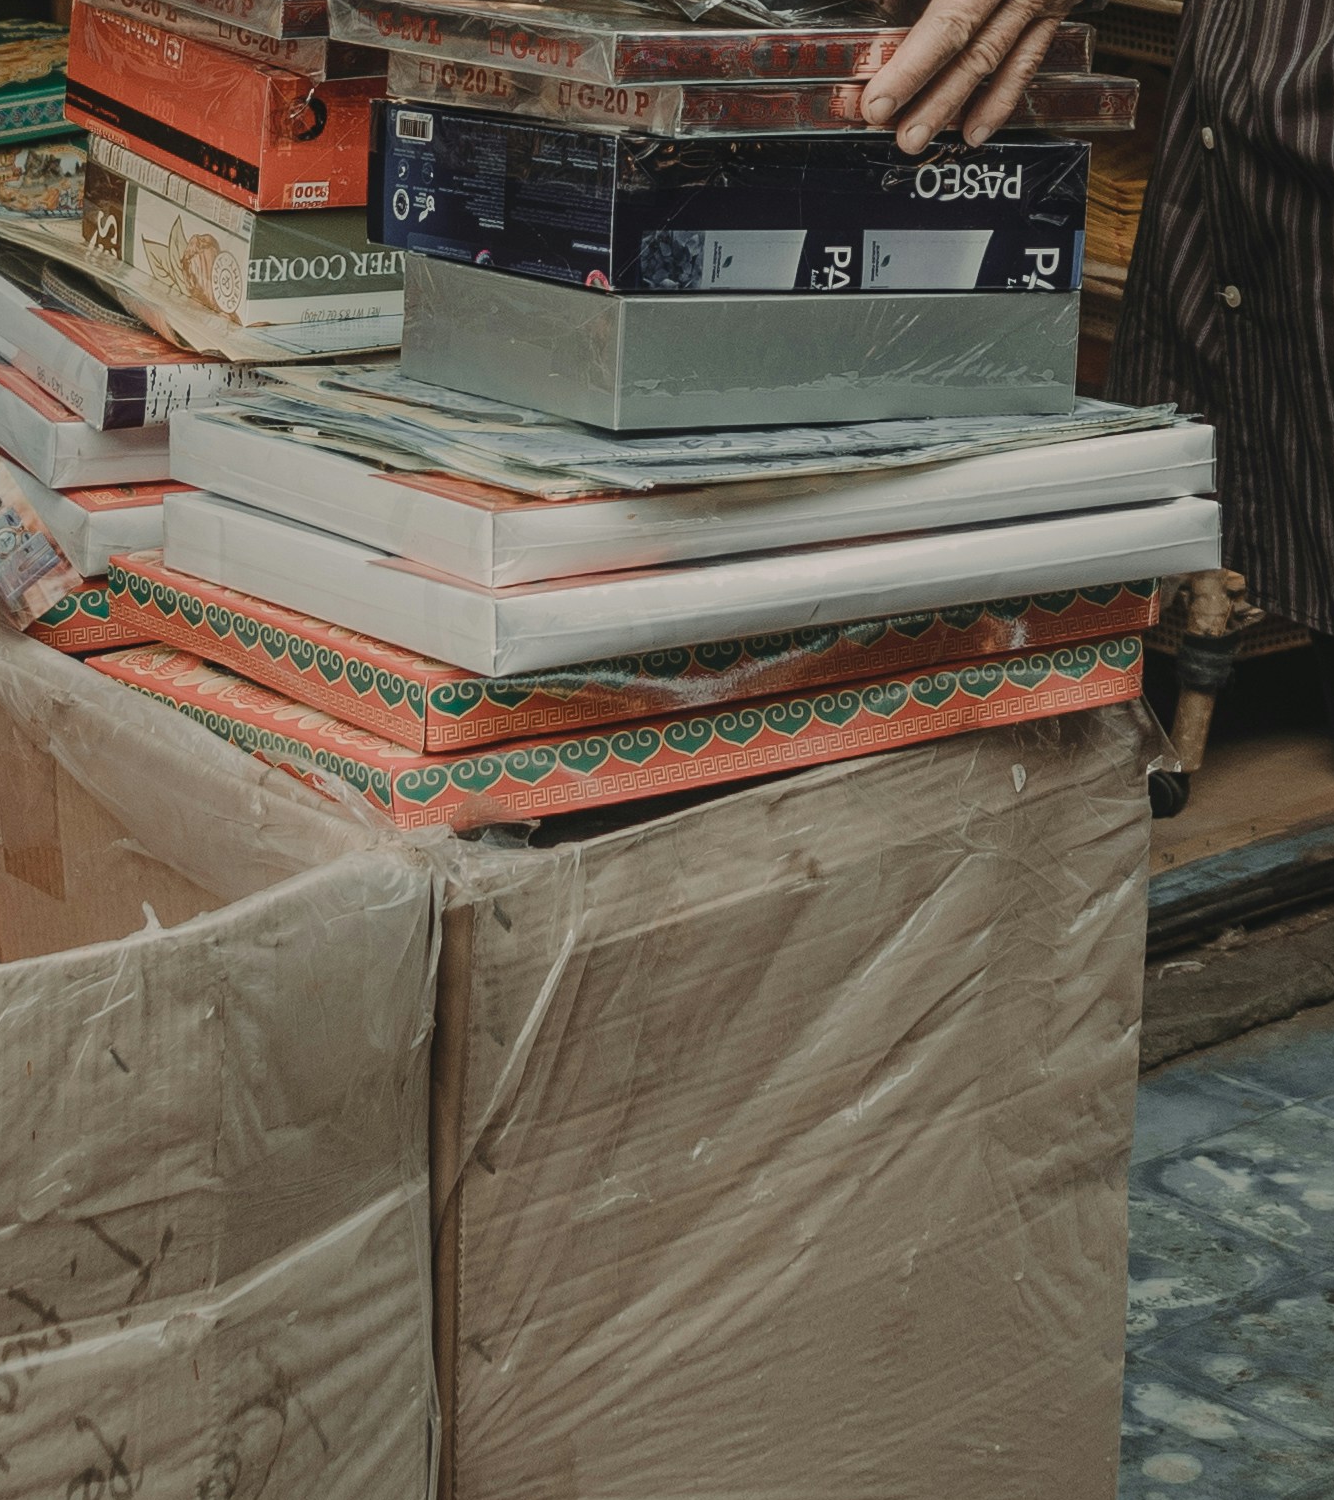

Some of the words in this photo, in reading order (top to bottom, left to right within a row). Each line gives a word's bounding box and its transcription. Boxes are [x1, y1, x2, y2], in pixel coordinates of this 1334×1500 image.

[376, 11, 424, 43] G-20
[510, 32, 562, 66] G-20
[440, 62, 488, 96] G-20
[577, 84, 629, 117] G-20
[915, 164, 1022, 201] PASEO
[248, 252, 346, 284] COOKIE
